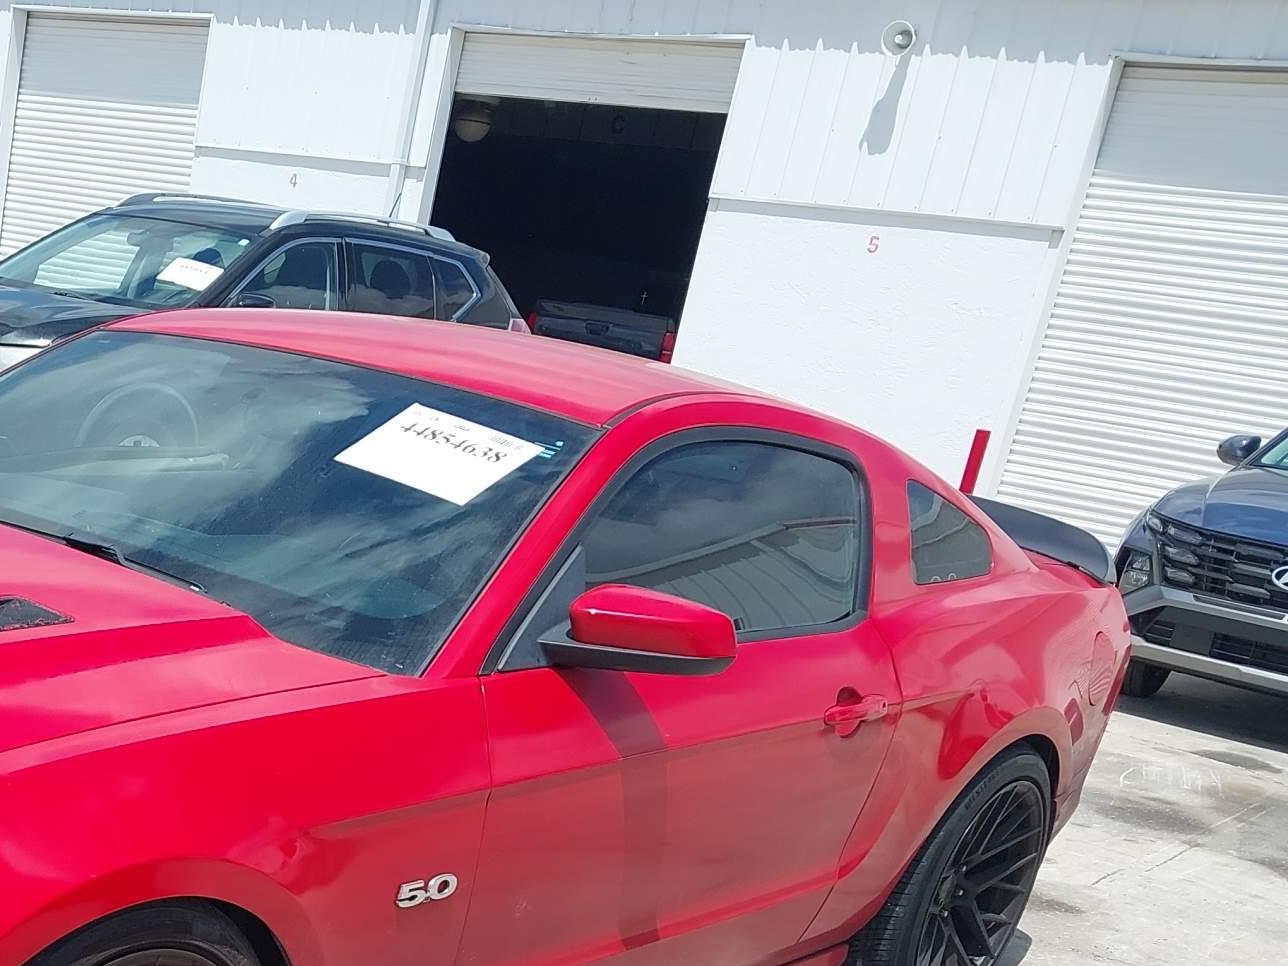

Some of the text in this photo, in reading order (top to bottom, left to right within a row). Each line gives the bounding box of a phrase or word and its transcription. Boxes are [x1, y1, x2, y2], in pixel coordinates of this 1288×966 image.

[289, 173, 297, 188] 4
[866, 235, 880, 253] 5
[400, 422, 508, 463] 44854638
